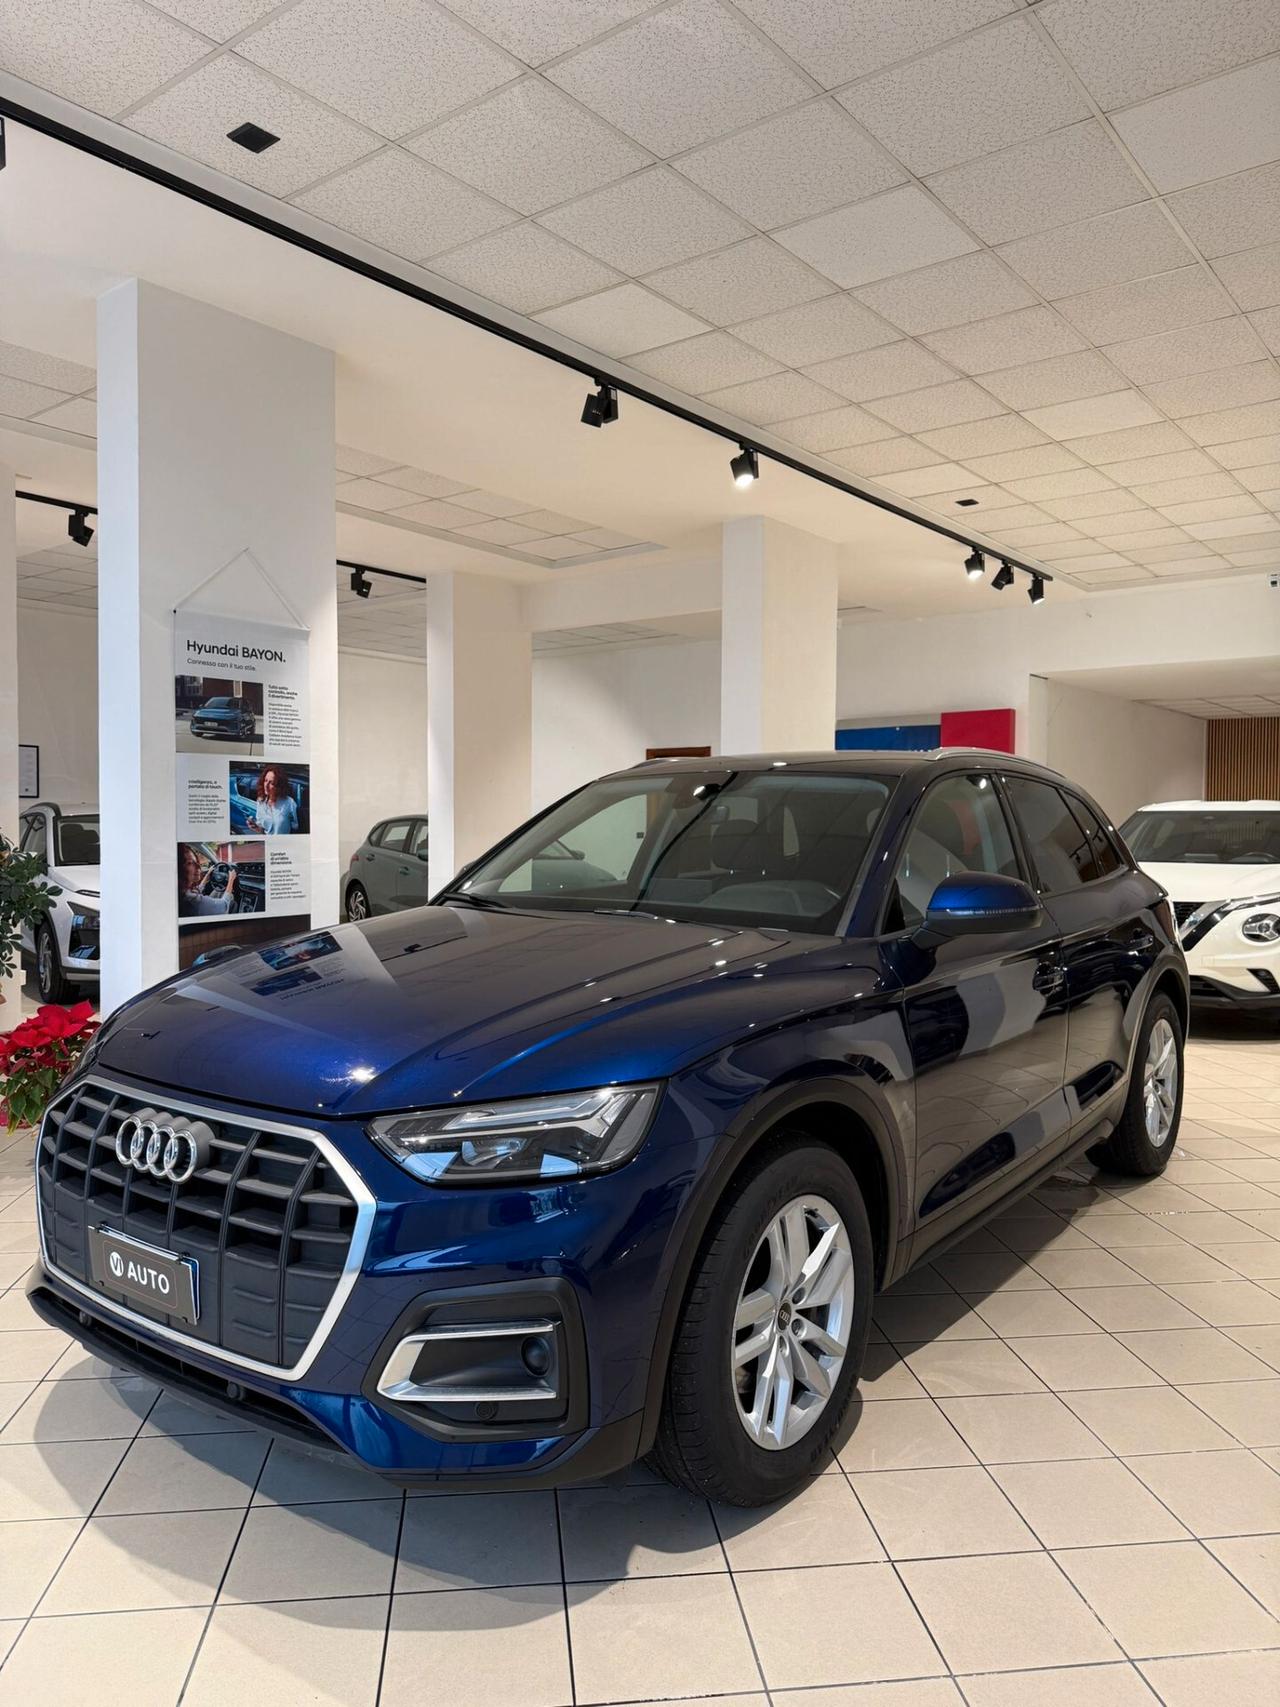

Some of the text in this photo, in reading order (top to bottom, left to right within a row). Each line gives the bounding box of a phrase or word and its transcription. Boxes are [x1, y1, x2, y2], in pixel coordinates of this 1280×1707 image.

[186, 639, 287, 663] Hyundai BAYON.
[186, 658, 217, 667] Connesso
[127, 1261, 170, 1295] AUTO
